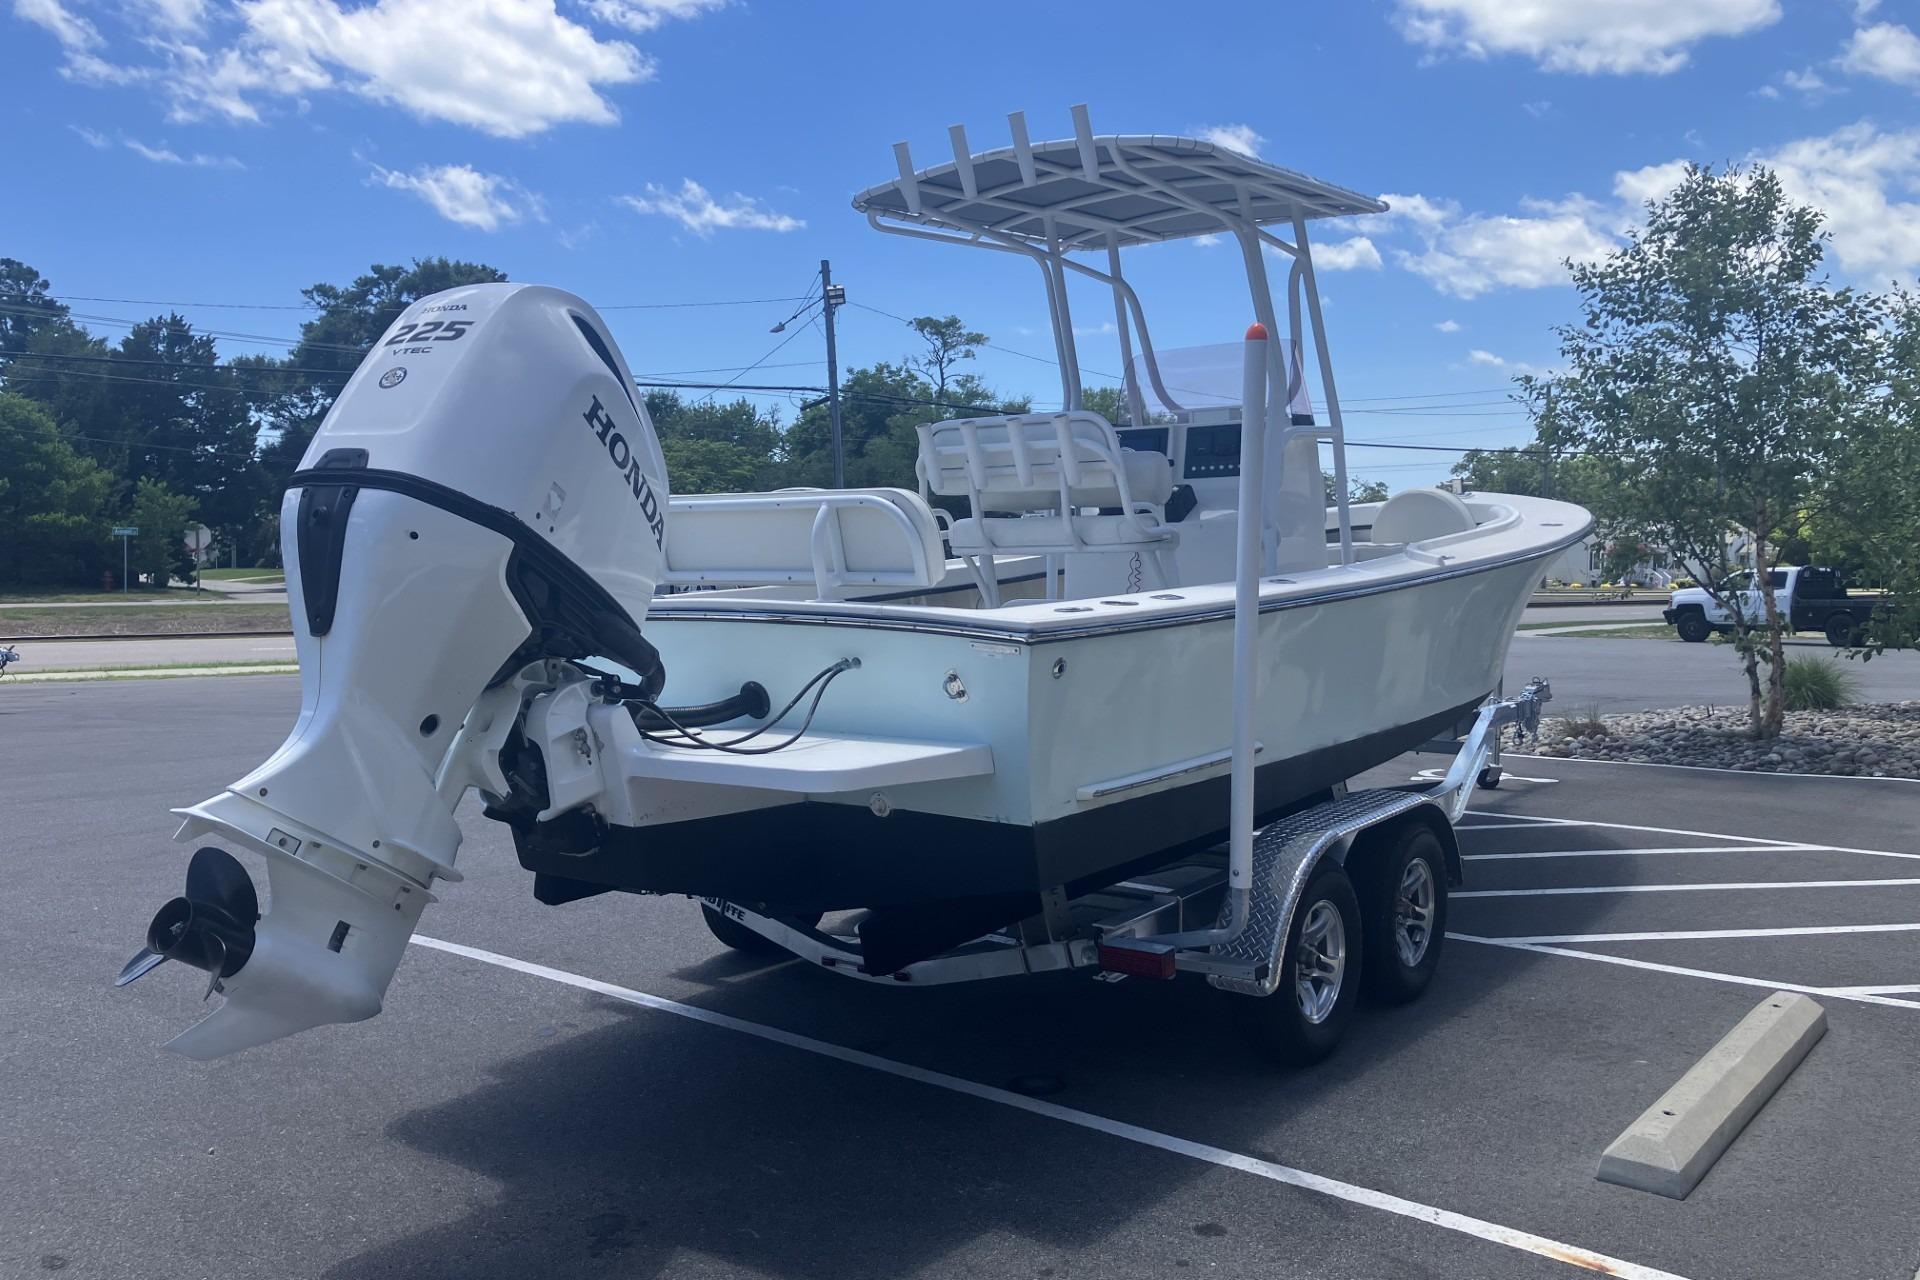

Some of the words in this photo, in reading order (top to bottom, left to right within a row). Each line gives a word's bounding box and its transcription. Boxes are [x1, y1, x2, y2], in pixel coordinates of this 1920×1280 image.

[421, 304, 467, 314] HONDA
[384, 321, 475, 347] 225
[393, 346, 433, 356] VTEC
[583, 394, 664, 552] HONDA
